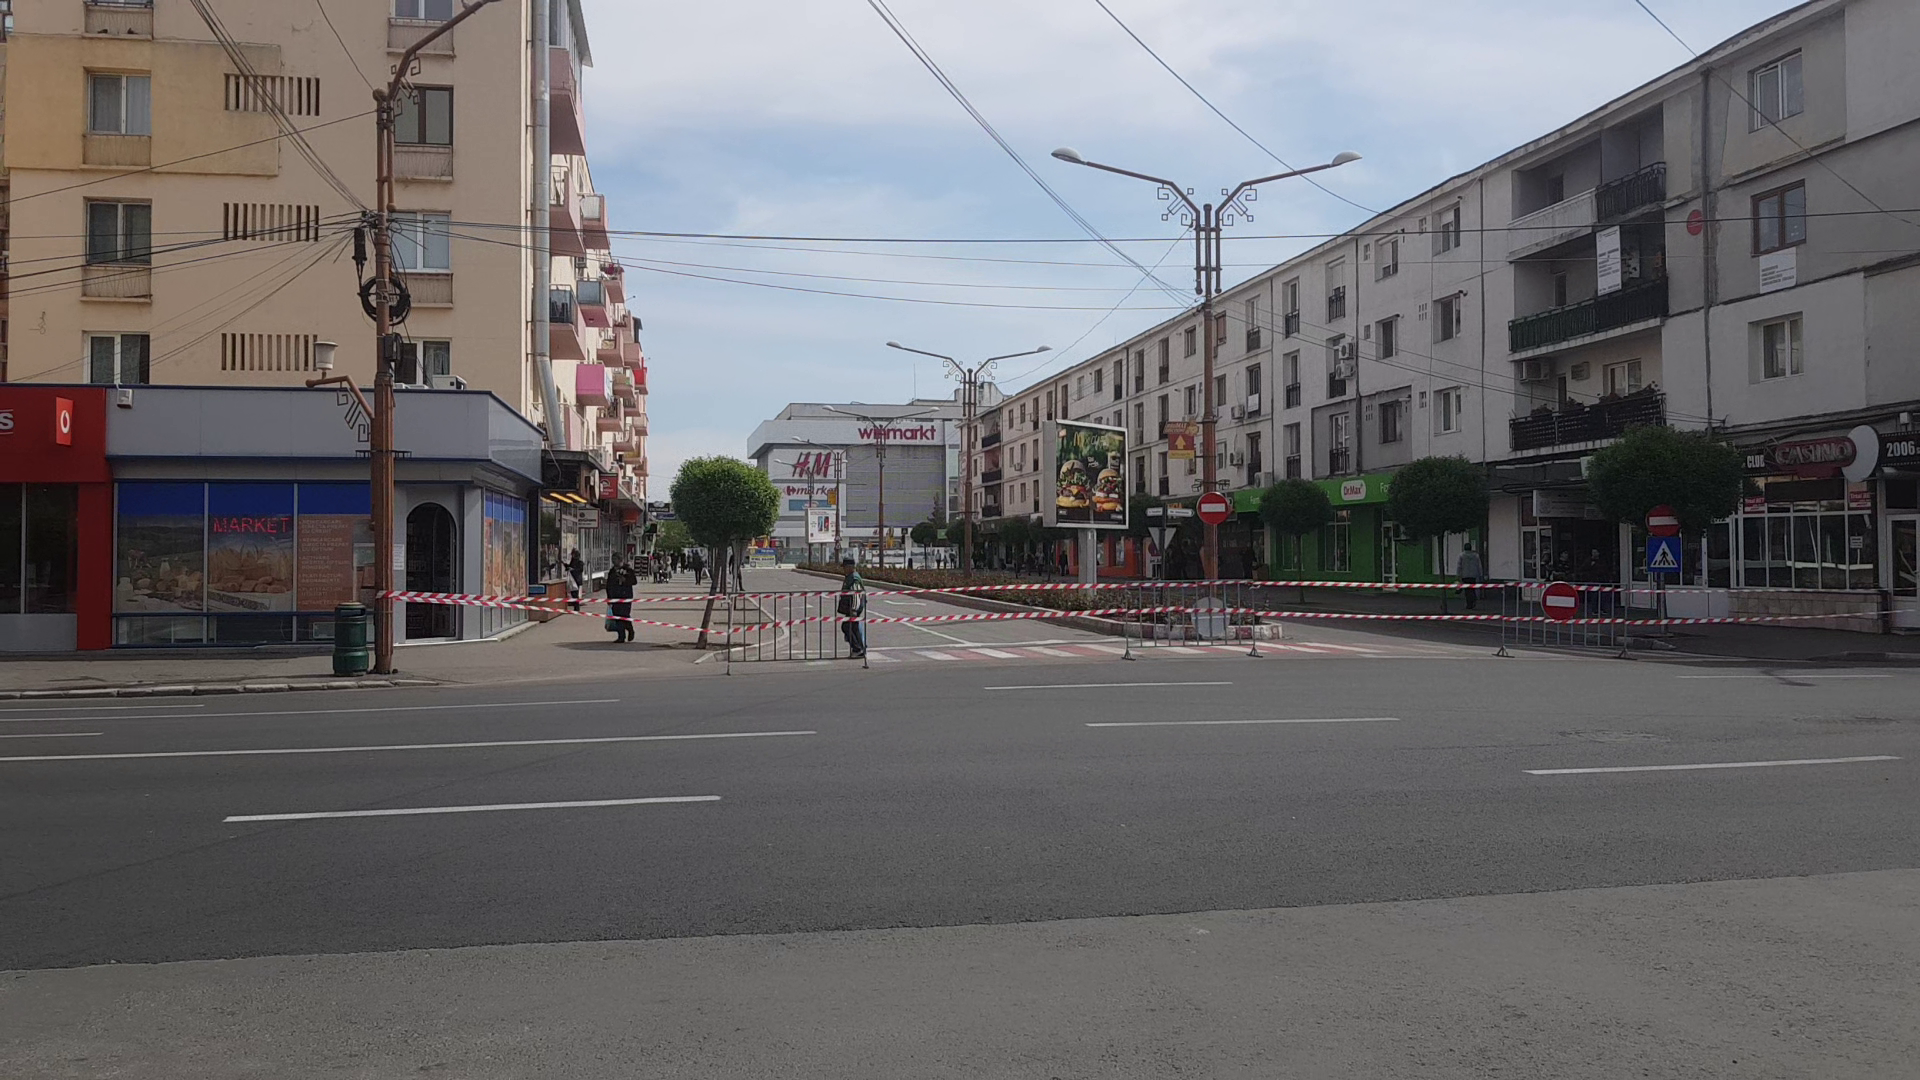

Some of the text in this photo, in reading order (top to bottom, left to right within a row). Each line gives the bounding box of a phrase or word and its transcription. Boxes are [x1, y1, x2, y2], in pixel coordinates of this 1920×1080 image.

[1775, 442, 1851, 465] CASINO
[1886, 441, 1915, 457] 2006
[792, 451, 831, 478] HM
[796, 485, 838, 495] marke
[213, 517, 290, 534] MARKET
